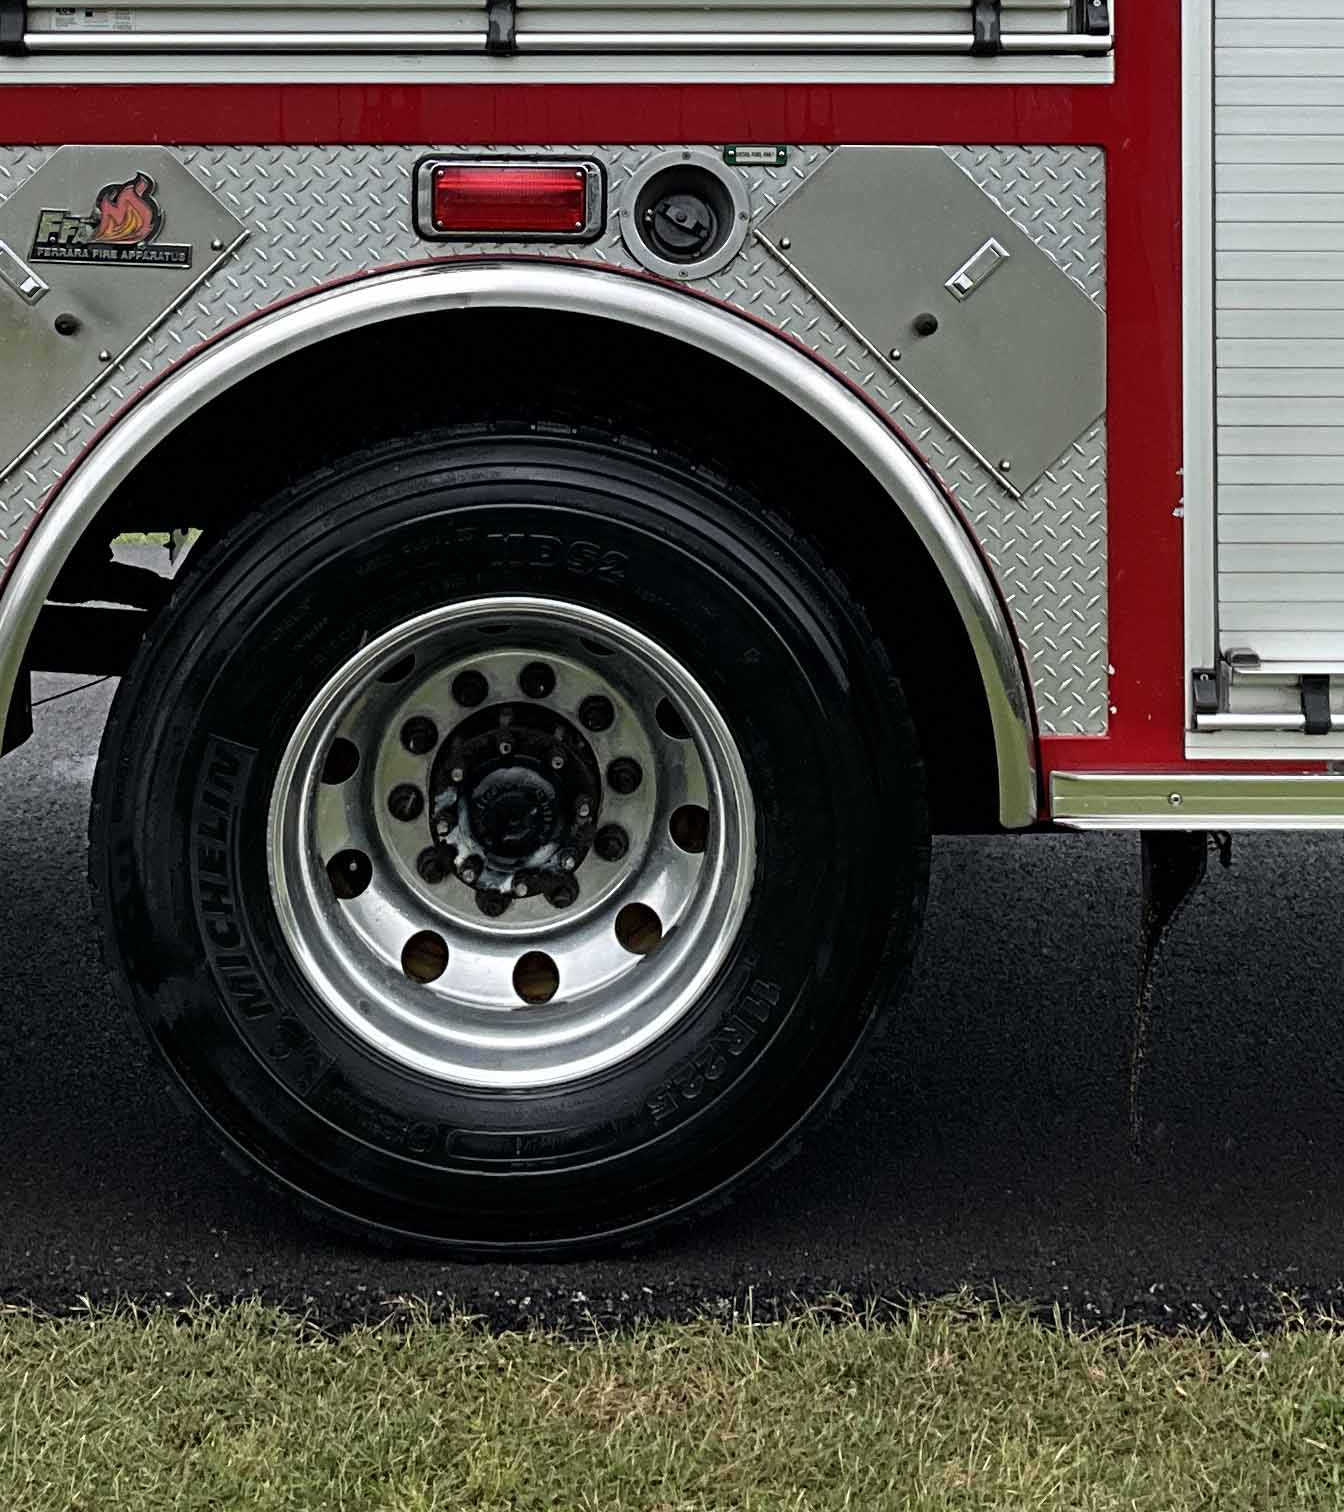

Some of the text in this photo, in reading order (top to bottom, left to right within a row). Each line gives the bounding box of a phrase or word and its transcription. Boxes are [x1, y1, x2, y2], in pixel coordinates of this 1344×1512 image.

[37, 247, 186, 262] FERRARA FIRE APPARATUS
[199, 741, 274, 1021] MICHELIN
